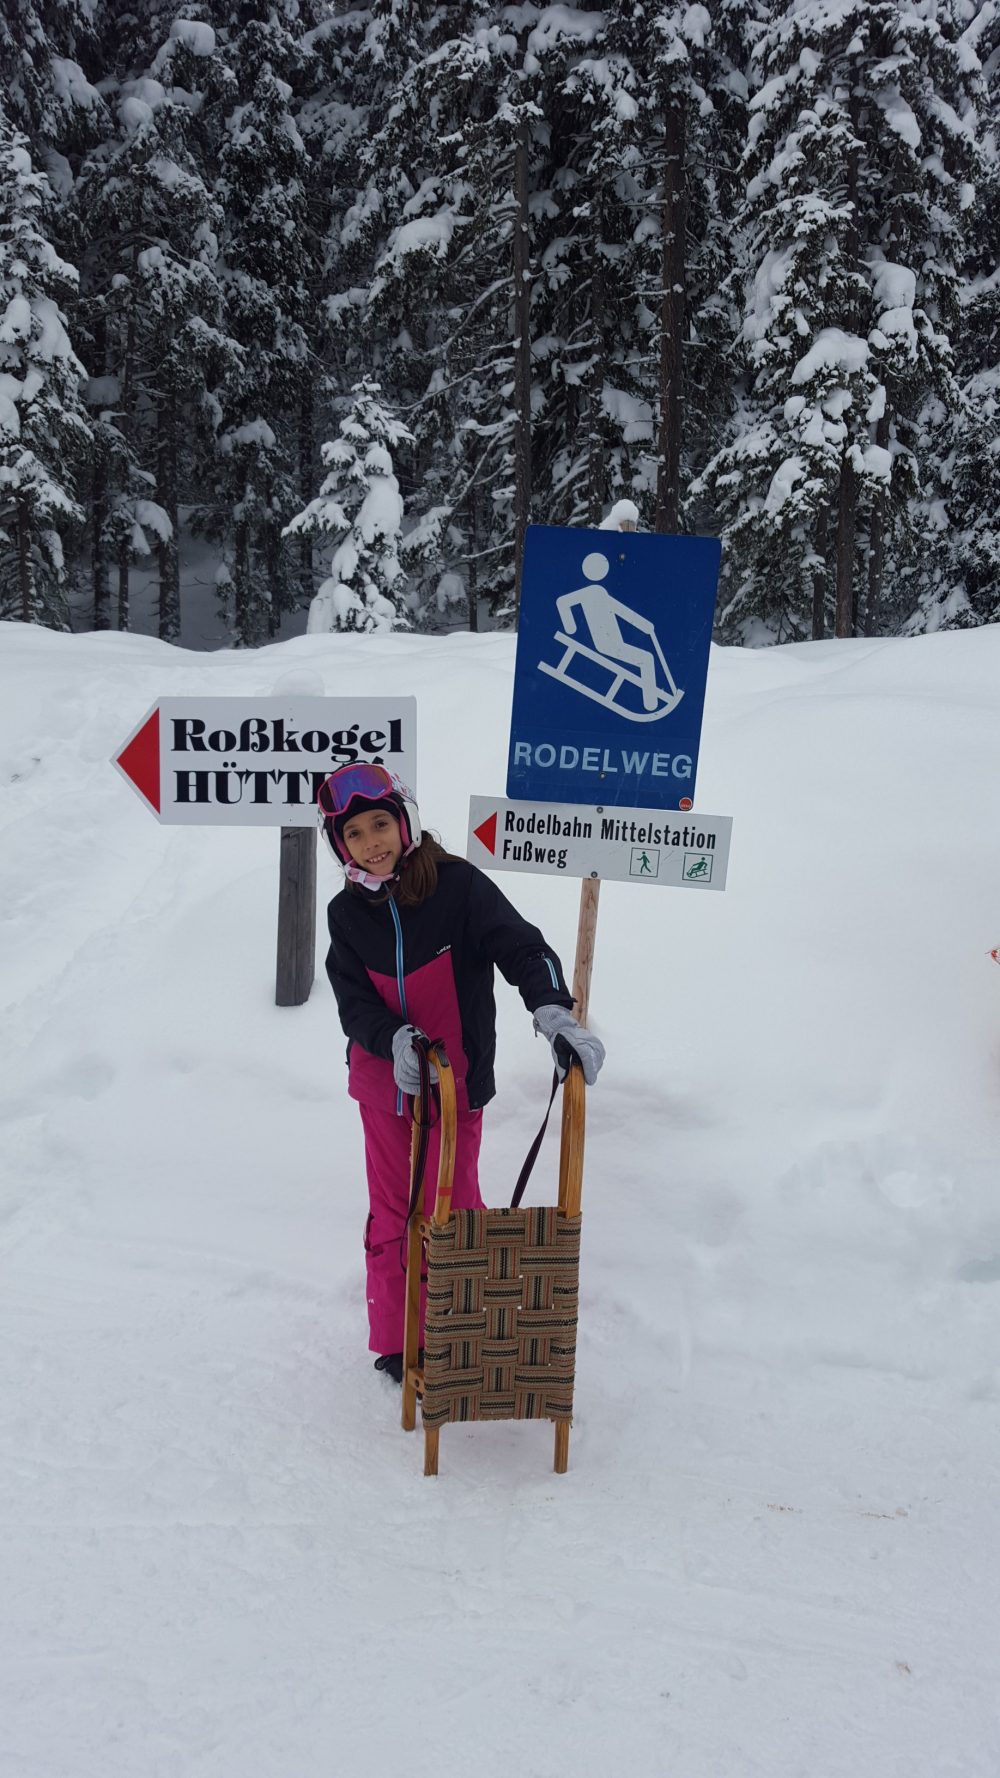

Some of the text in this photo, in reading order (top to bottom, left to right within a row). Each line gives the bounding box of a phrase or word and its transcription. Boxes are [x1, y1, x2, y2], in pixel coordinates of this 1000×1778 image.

[170, 718, 404, 763] Roßkogel
[513, 742, 692, 778] RODELWEG
[504, 810, 716, 850] Rodelbahn Mittelstation
[502, 839, 568, 869] Fußweg
